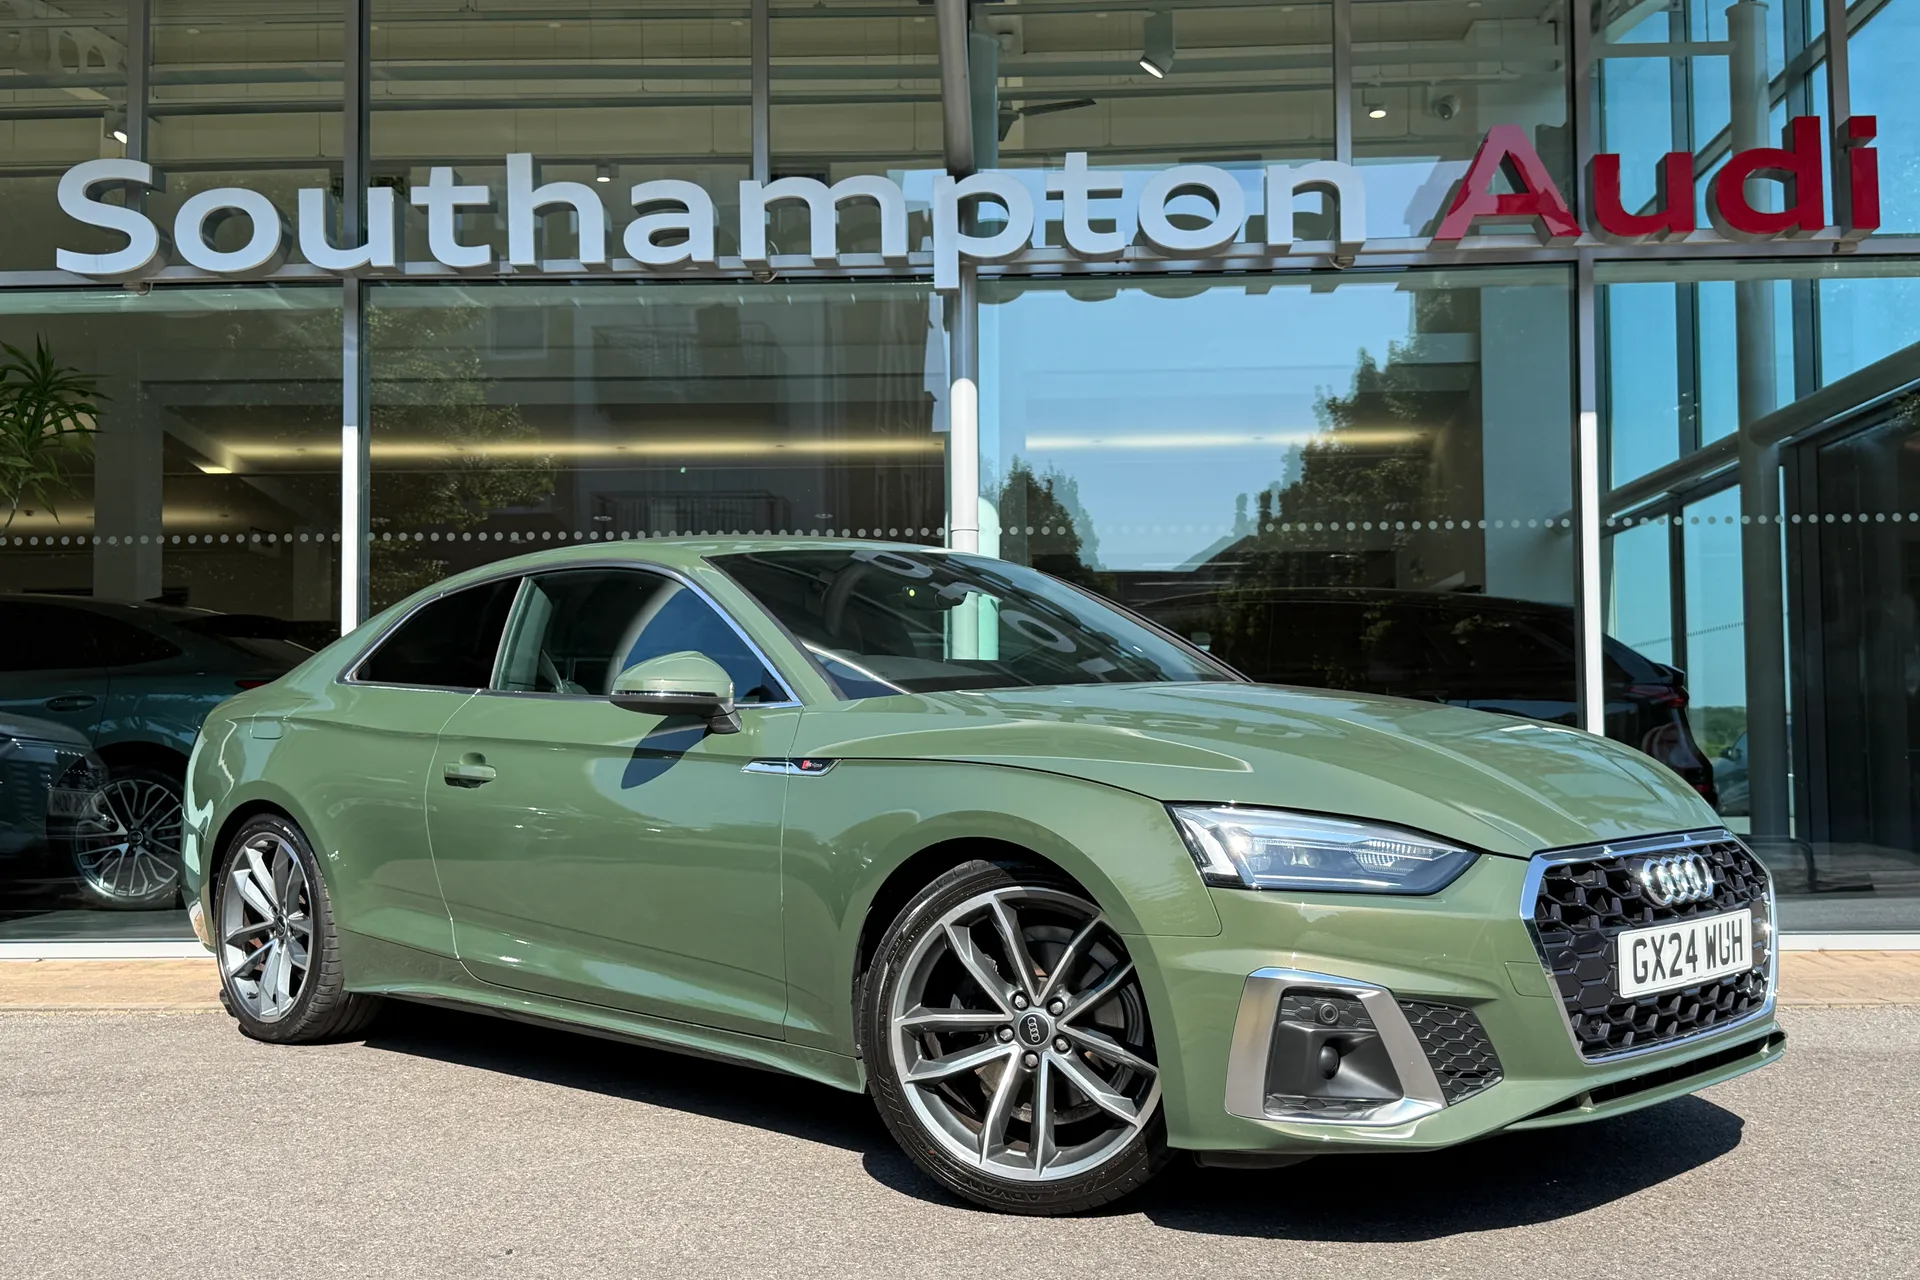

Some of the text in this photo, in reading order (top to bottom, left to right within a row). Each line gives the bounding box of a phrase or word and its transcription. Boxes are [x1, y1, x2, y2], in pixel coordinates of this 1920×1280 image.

[56, 115, 1881, 290] Southampton Audi
[1632, 918, 1744, 984] GX24 WUH
